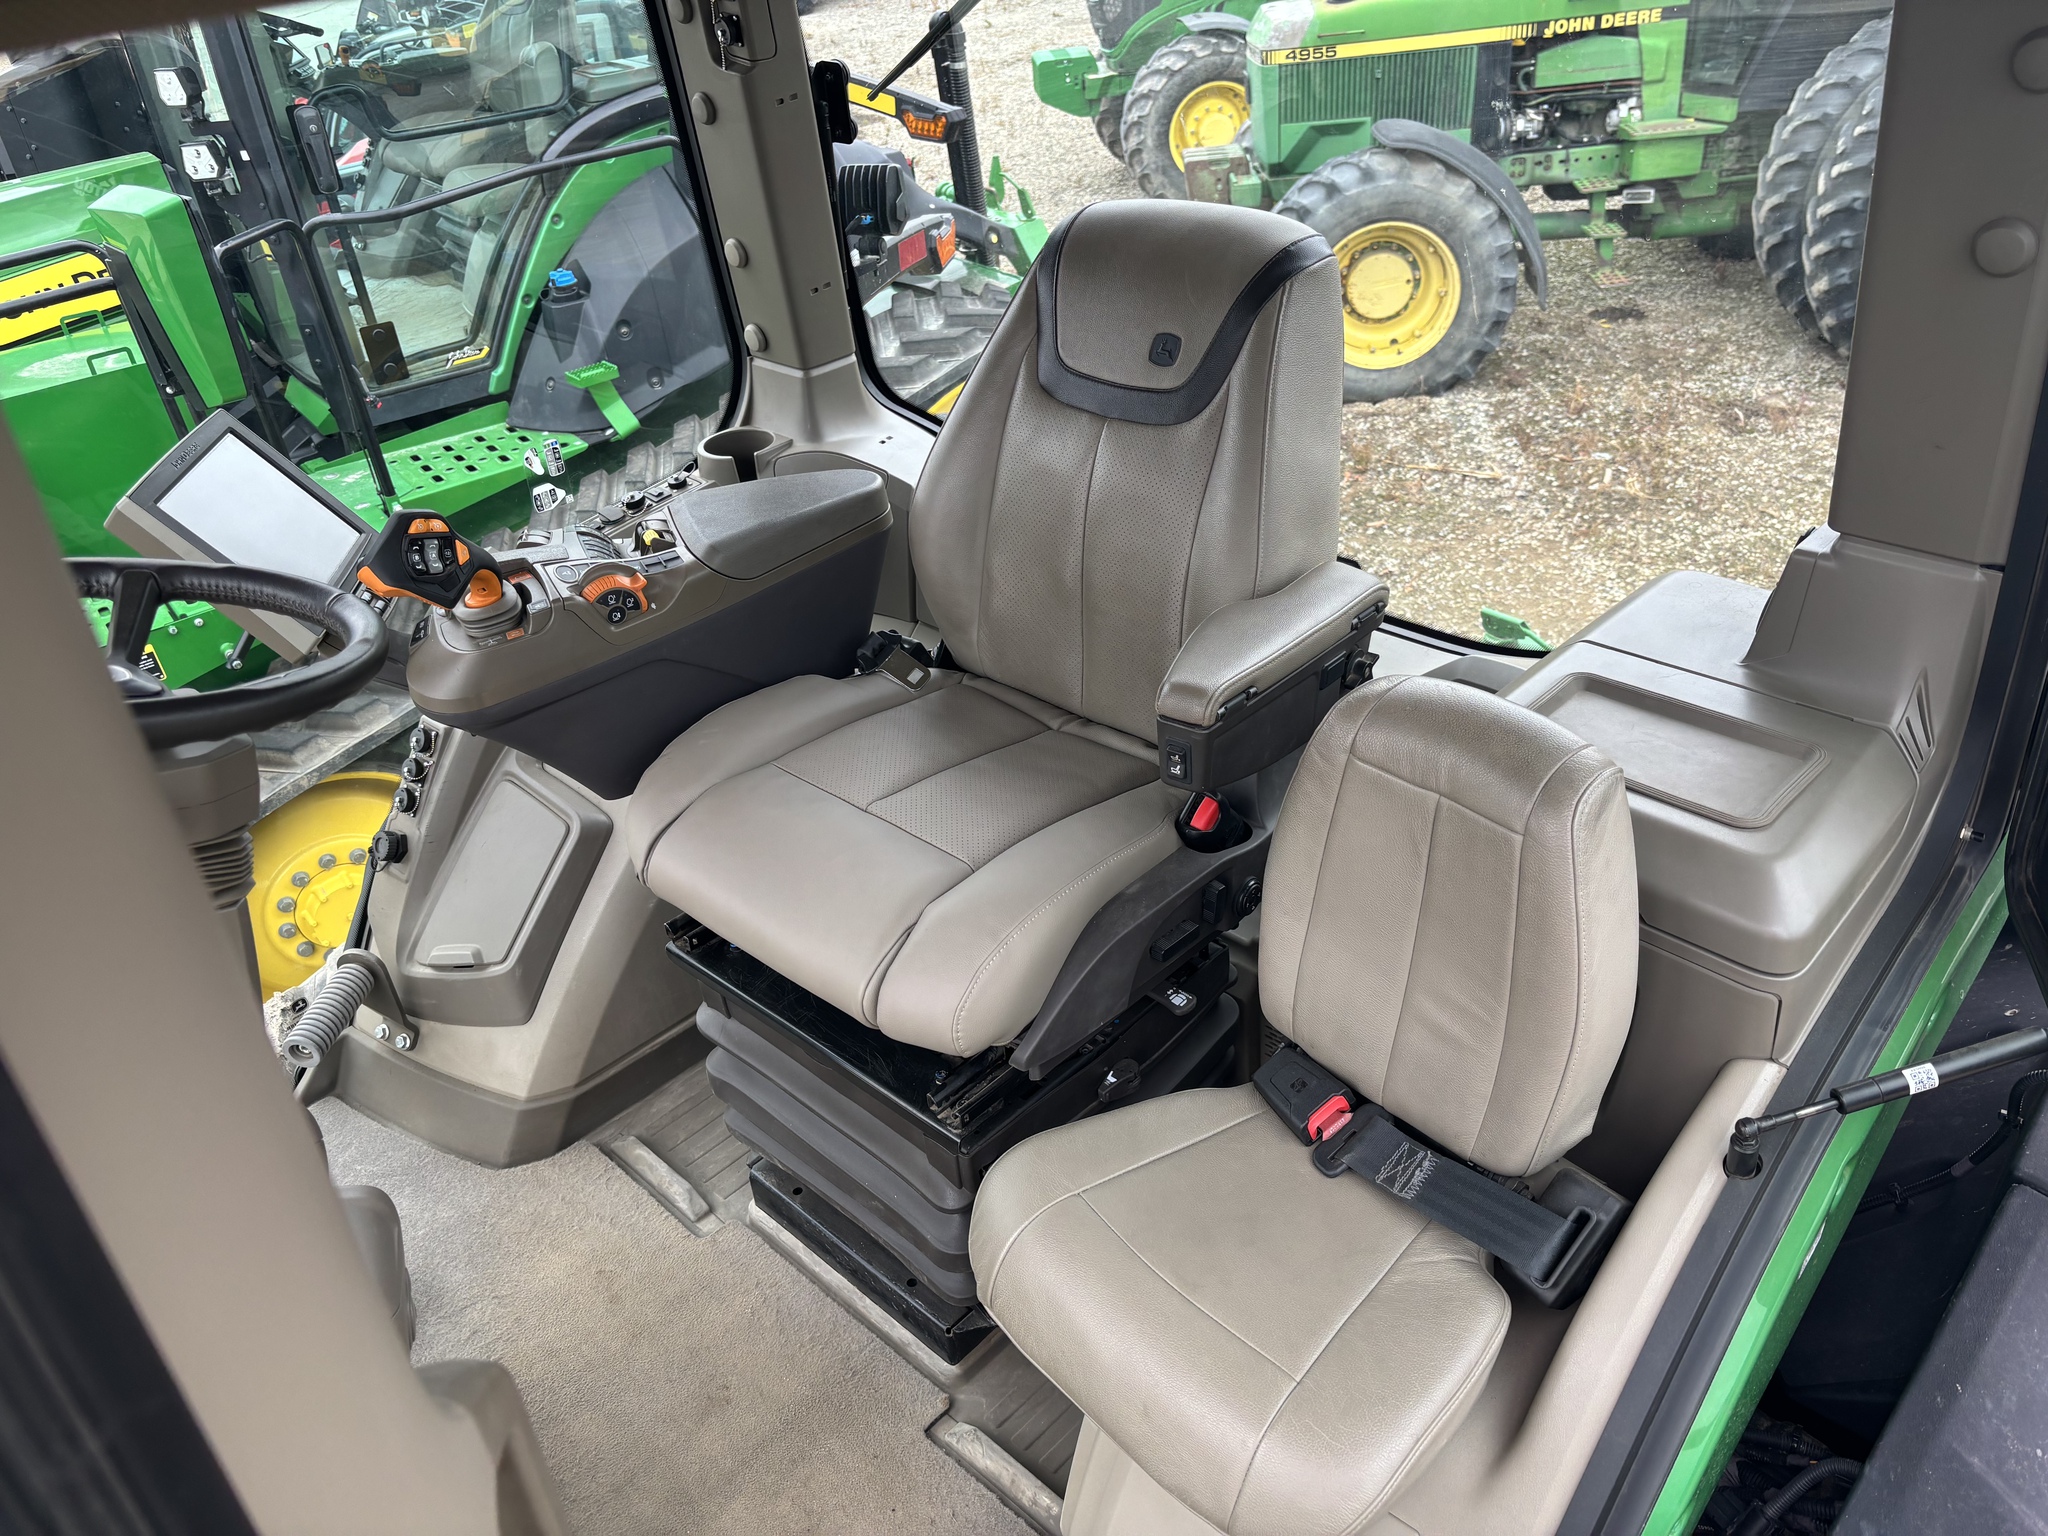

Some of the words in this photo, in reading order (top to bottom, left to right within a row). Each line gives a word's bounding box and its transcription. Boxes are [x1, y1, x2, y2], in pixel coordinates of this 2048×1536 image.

[1543, 16, 1595, 36] JOHN
[1601, 8, 1662, 29] DEERE
[1285, 45, 1337, 61] 4955
